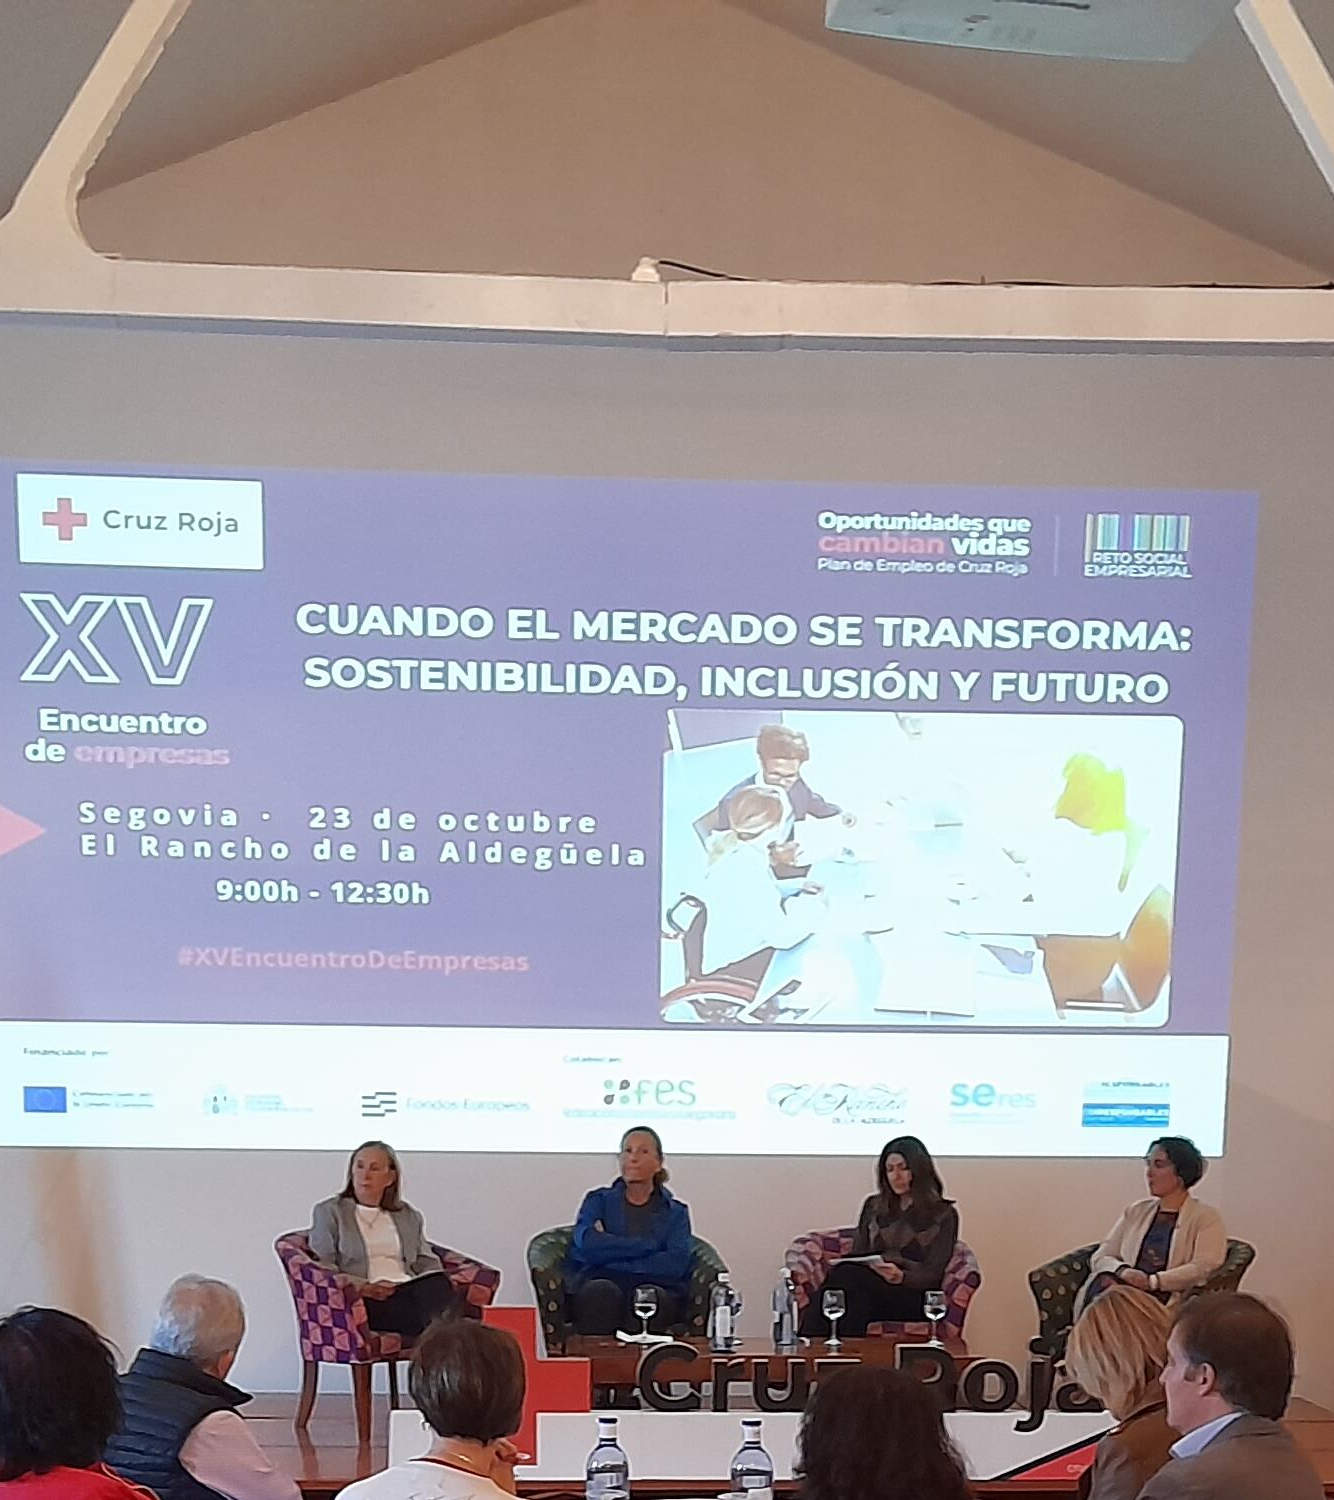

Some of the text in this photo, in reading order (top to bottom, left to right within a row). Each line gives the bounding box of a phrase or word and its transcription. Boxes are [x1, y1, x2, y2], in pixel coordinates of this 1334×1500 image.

[102, 508, 240, 538] Cruz Roja
[818, 511, 1032, 534] Oportunidades que
[818, 532, 1031, 557] cambian vidas
[1092, 552, 1188, 566] RETO SOCIAL
[817, 556, 1029, 577] Plan de Empleo de Cruz Roja
[1084, 565, 1192, 578] EMPRESARIAL
[19, 592, 215, 686] XV
[295, 602, 1192, 652] CUANDO EL MERCADO SE TRANSFORMA:
[303, 657, 1170, 704] SOSTENIBILIDAD, INCLUSIÓN Y FUTURO
[38, 708, 208, 736] Encuentro
[24, 739, 231, 769] de empresas
[78, 801, 240, 831] Segovia
[308, 806, 352, 830] 23
[373, 806, 418, 832] de
[438, 807, 598, 835] octubre
[80, 832, 117, 856] El
[140, 833, 291, 861] Rancho
[312, 836, 358, 862] de
[380, 837, 416, 863] la
[215, 878, 299, 903] 9:00h
[331, 880, 431, 906] 12:30h
[177, 946, 531, 976] #XVEncuentroDeEmpresas
[406, 1096, 531, 1114] Fondos Europeos
[633, 1078, 697, 1107] fes
